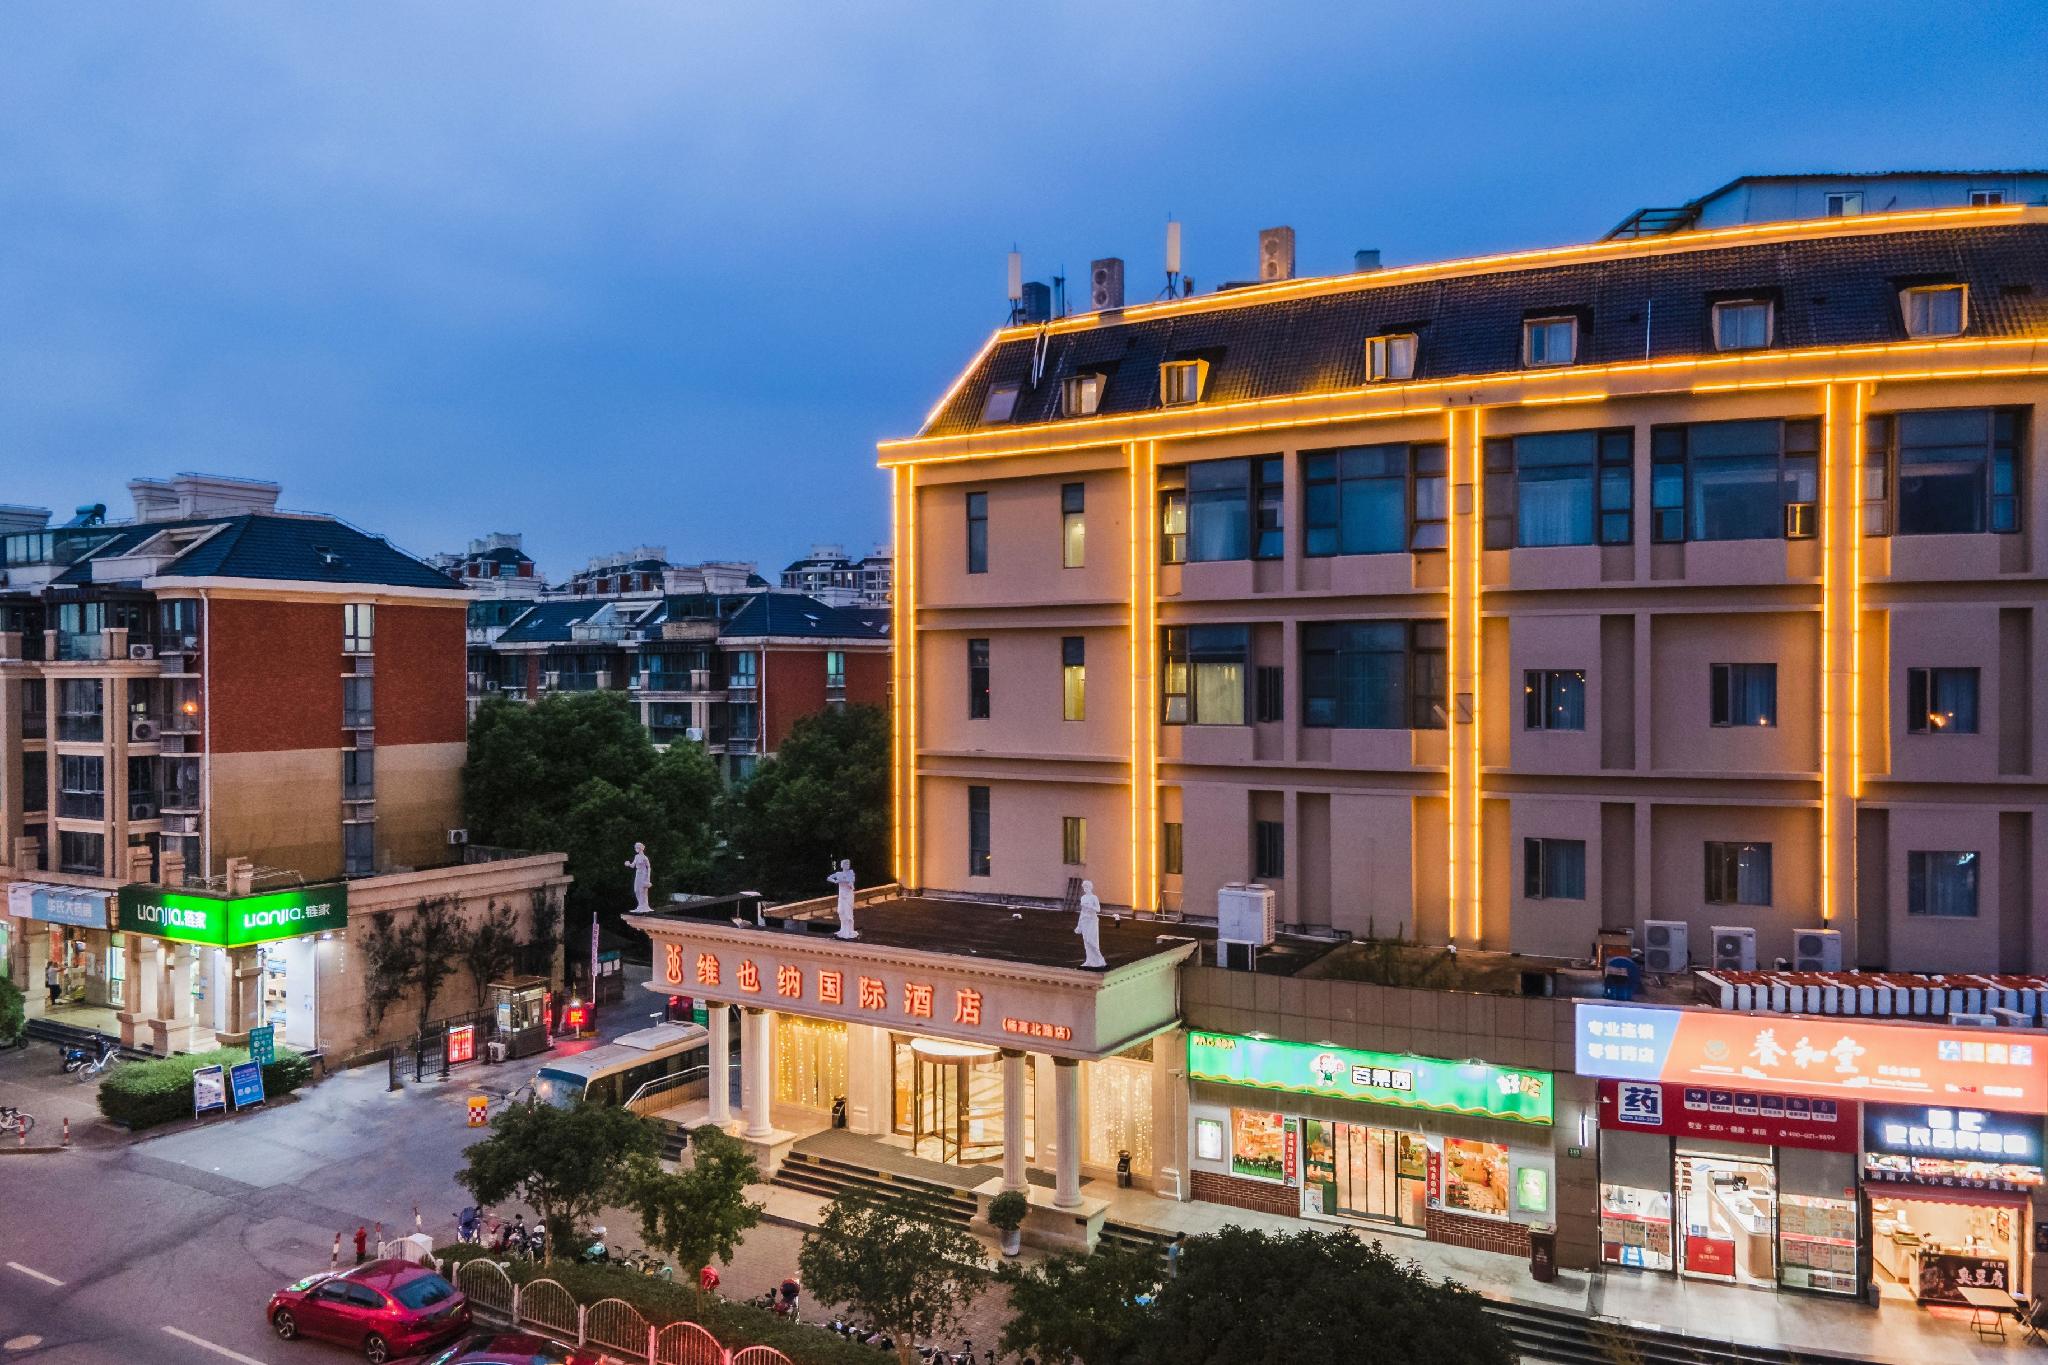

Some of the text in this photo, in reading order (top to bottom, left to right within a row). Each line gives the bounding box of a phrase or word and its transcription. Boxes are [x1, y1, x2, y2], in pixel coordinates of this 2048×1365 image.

[696, 953, 984, 1026] 维也纳国际酒店
[1351, 1065, 1412, 1091] 百果园
[1624, 1086, 1658, 1114] 药
[1955, 1266, 2004, 1288] 臭豆腐
